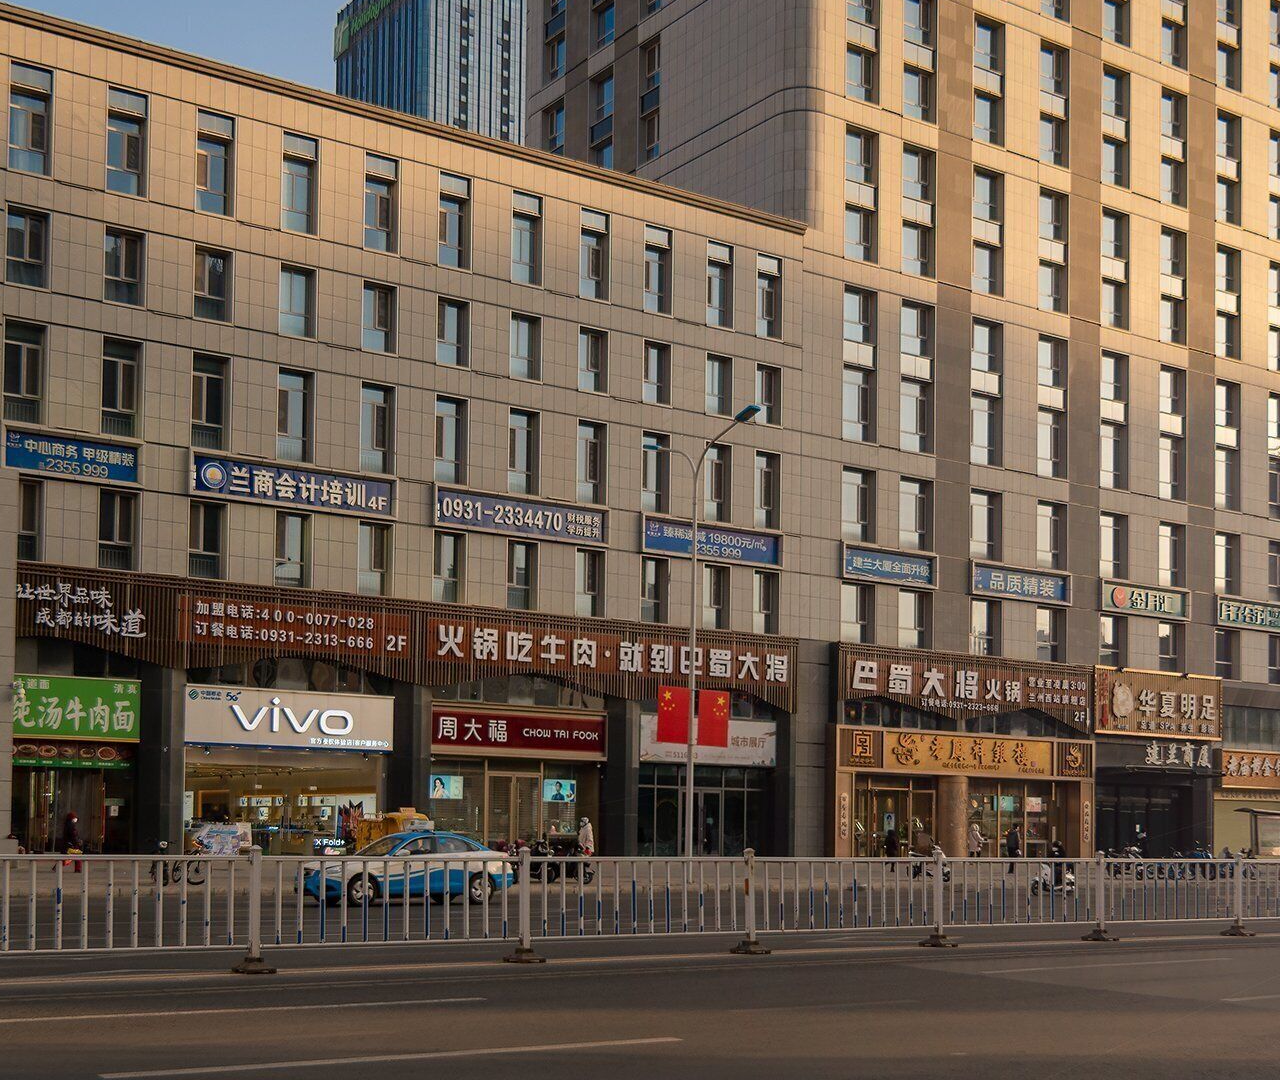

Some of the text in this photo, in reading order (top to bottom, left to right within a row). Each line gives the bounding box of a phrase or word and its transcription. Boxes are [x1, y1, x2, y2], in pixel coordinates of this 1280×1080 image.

[24, 439, 135, 467] 中心商务 甲级精装
[46, 458, 109, 478] 2355 999
[229, 466, 388, 511] 兰商会计培训 4F
[442, 497, 563, 531] 0931-2334470
[566, 512, 601, 527] 财税服务
[566, 525, 601, 538] 学历提升
[721, 547, 742, 559] 999
[852, 556, 930, 578] 建兰大厦全面升级
[16, 582, 113, 608] 让世界品味
[989, 572, 1055, 598] 品质精装
[35, 607, 147, 638] 成都的味道
[386, 635, 407, 652] 2F
[231, 697, 354, 735] vivo
[1137, 689, 1216, 720] 华夏明足
[438, 716, 599, 742] 周大福 CHOW TAI FOOK
